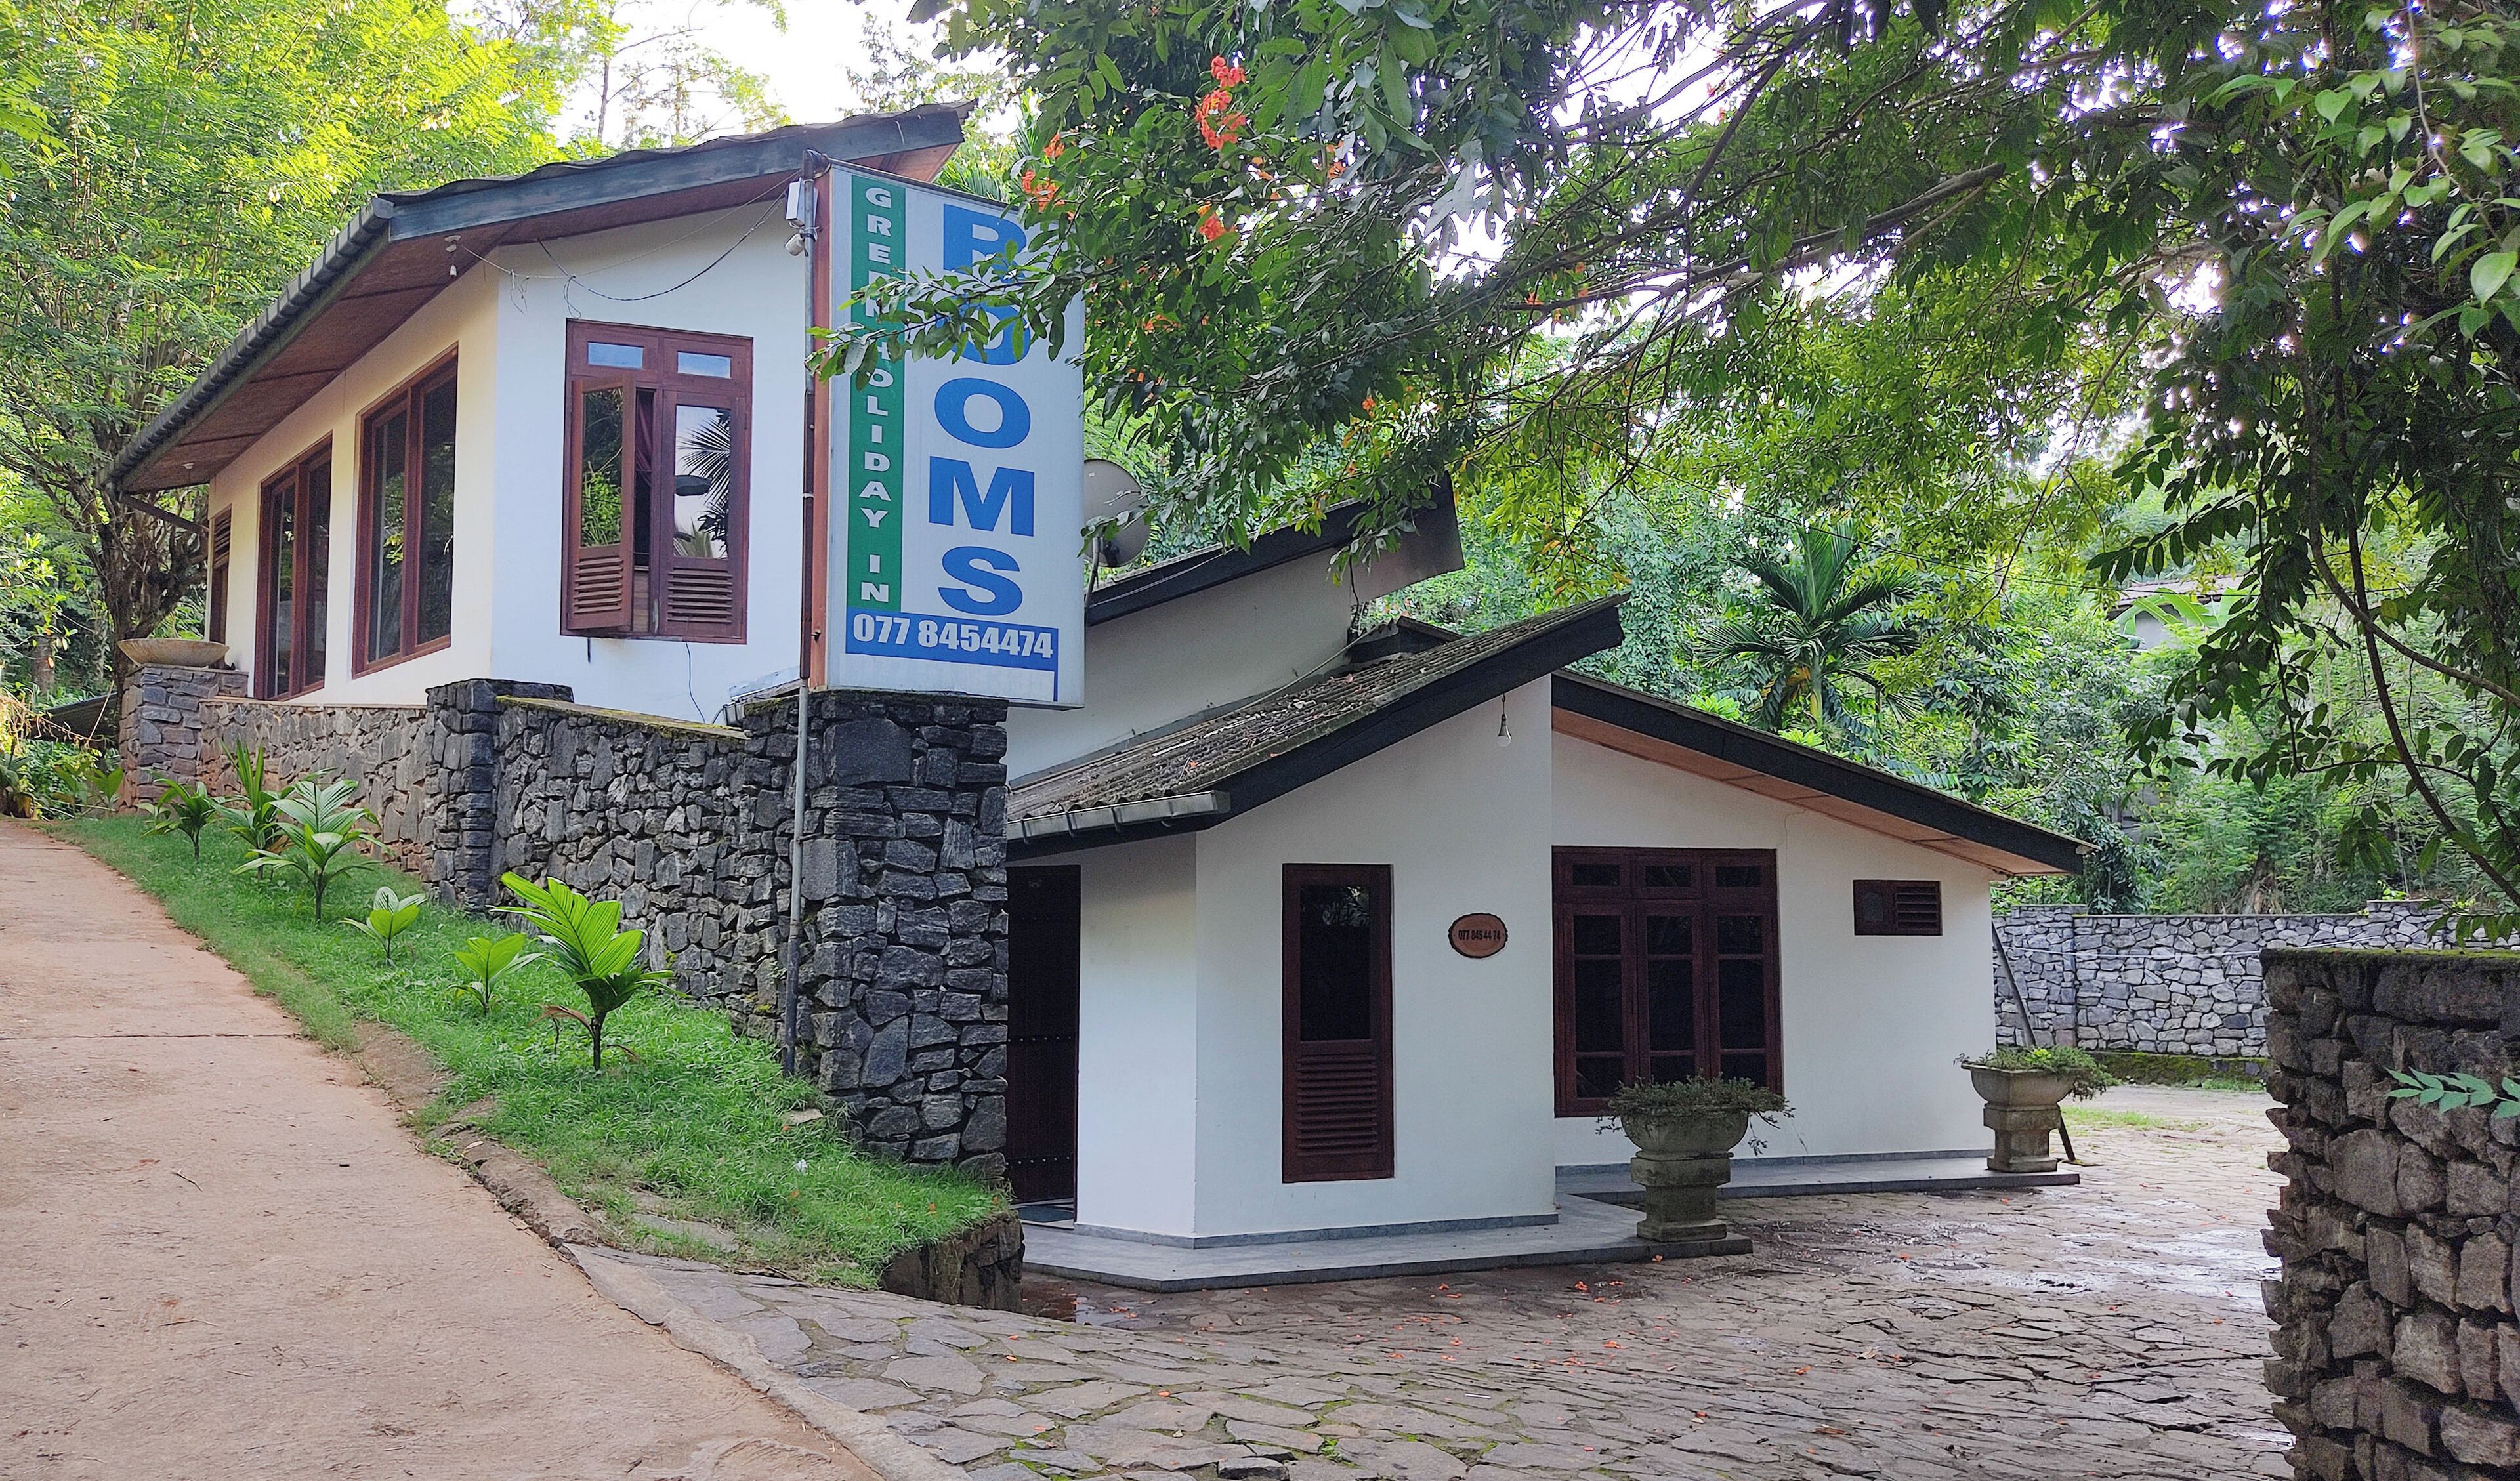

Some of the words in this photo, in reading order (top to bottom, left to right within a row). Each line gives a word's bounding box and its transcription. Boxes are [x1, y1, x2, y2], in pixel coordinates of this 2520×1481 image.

[860, 554, 889, 603] IN
[853, 614, 910, 645] 077
[918, 620, 1053, 659] 8454474
[1458, 930, 1469, 940] 077
[1493, 930, 1501, 940] 74
